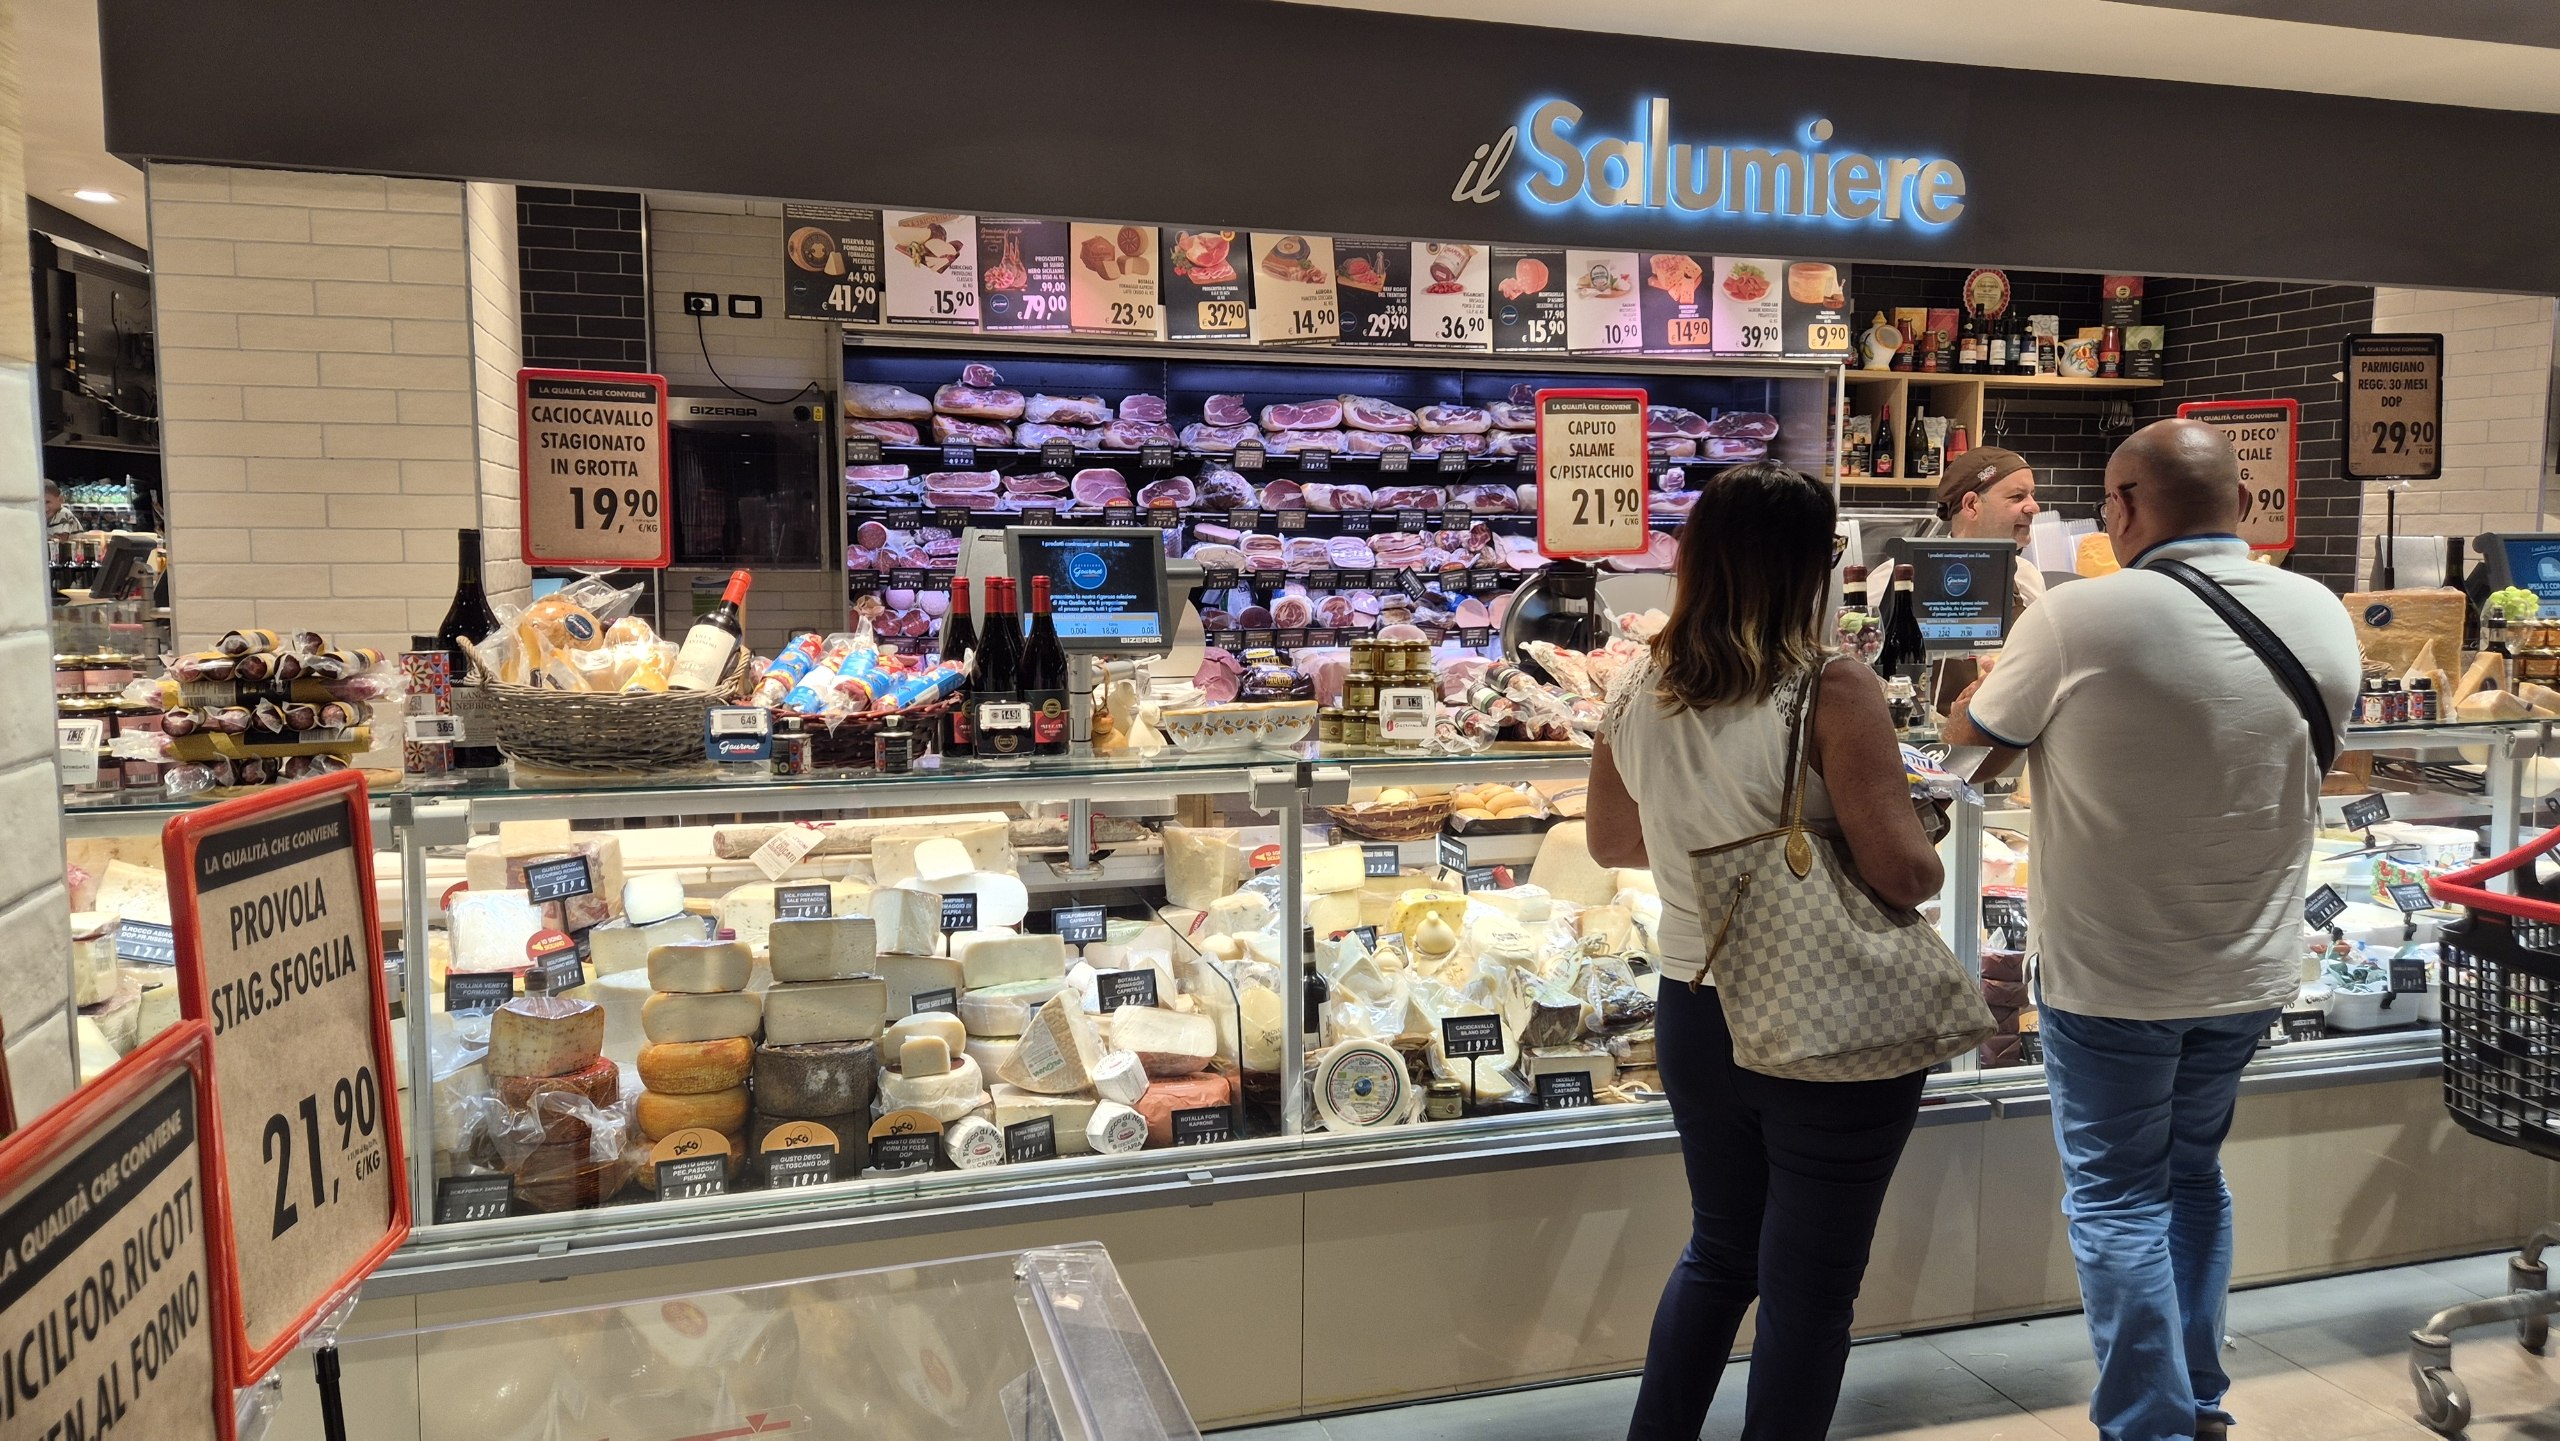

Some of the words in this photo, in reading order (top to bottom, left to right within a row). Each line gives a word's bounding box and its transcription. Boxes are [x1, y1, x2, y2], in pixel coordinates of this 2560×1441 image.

[1451, 126, 1518, 204] il
[1522, 97, 1966, 225] Salumiere
[848, 272, 876, 284] 44,90
[828, 284, 876, 313] 41,90
[934, 290, 974, 314] 15,90
[1022, 295, 1067, 320] 79,00
[1111, 302, 1154, 327] 23,90
[1208, 303, 1244, 327] 32,90
[1385, 305, 1407, 316] 33,90
[1544, 310, 1564, 319] 17,90
[1293, 309, 1335, 335] 14,90
[1368, 314, 1408, 338] 29,90
[1441, 316, 1484, 340] 36,90
[1528, 319, 1565, 343] 15,90
[1676, 321, 1708, 342] 14,90
[1605, 324, 1638, 345] 10,90
[1741, 326, 1778, 349] 39,90
[1817, 326, 1845, 348] 9,90
[2362, 362, 2424, 372] PARMIGIANO
[539, 386, 550, 394] LA
[552, 386, 586, 395] QUALITÀ
[606, 390, 646, 398] CONVIENE
[2358, 379, 2387, 390] REGG.
[2389, 379, 2401, 390] 30
[2404, 378, 2428, 390] MESI
[690, 406, 758, 416] BIZERBA
[2381, 396, 2402, 407] DOP
[532, 406, 653, 427] CACIOCAVALLO
[1568, 421, 1616, 435] CAPUTO
[2242, 428, 2279, 441] DECO'
[2372, 421, 2434, 456] 29,90
[541, 432, 645, 452] STAGIONATO
[1569, 443, 1615, 457] SALAME
[2235, 448, 2272, 461] CIALE
[551, 458, 568, 475] IN
[575, 459, 638, 477] GROTTA
[1550, 465, 1634, 480] C/PISTACCHIO
[2240, 468, 2254, 480] G.
[570, 487, 658, 533] 19,90
[1572, 488, 1639, 527] 21,90
[638, 523, 658, 533] €/KG
[436, 722, 454, 733] 3.69
[740, 715, 756, 725] 6.49
[719, 741, 760, 754] Gourmet
[204, 857, 219, 875] LA
[222, 838, 268, 869] QUALITÀ
[271, 836, 289, 855] CHE
[292, 822, 339, 849] CONVIENE
[230, 877, 327, 950] PROVOLA
[212, 934, 356, 1036] STAG.SFOGLIA
[1115, 981, 1145, 989] FORMAGGIO
[263, 1066, 376, 1241] 21,90
[356, 1150, 381, 1181] €/KG
[673, 1166, 716, 1176] PEC.PASCOLI
[771, 1161, 815, 1171] PEC.TOSCANO
[0, 1247, 18, 1284] A
[20, 1182, 90, 1264] QUALITÀ
[91, 1162, 120, 1203] CHE
[120, 1108, 183, 1180] CONVIENE
[0, 1176, 194, 1422] ICILFOR.RICOTT
[130, 1270, 199, 1400] FORNO
